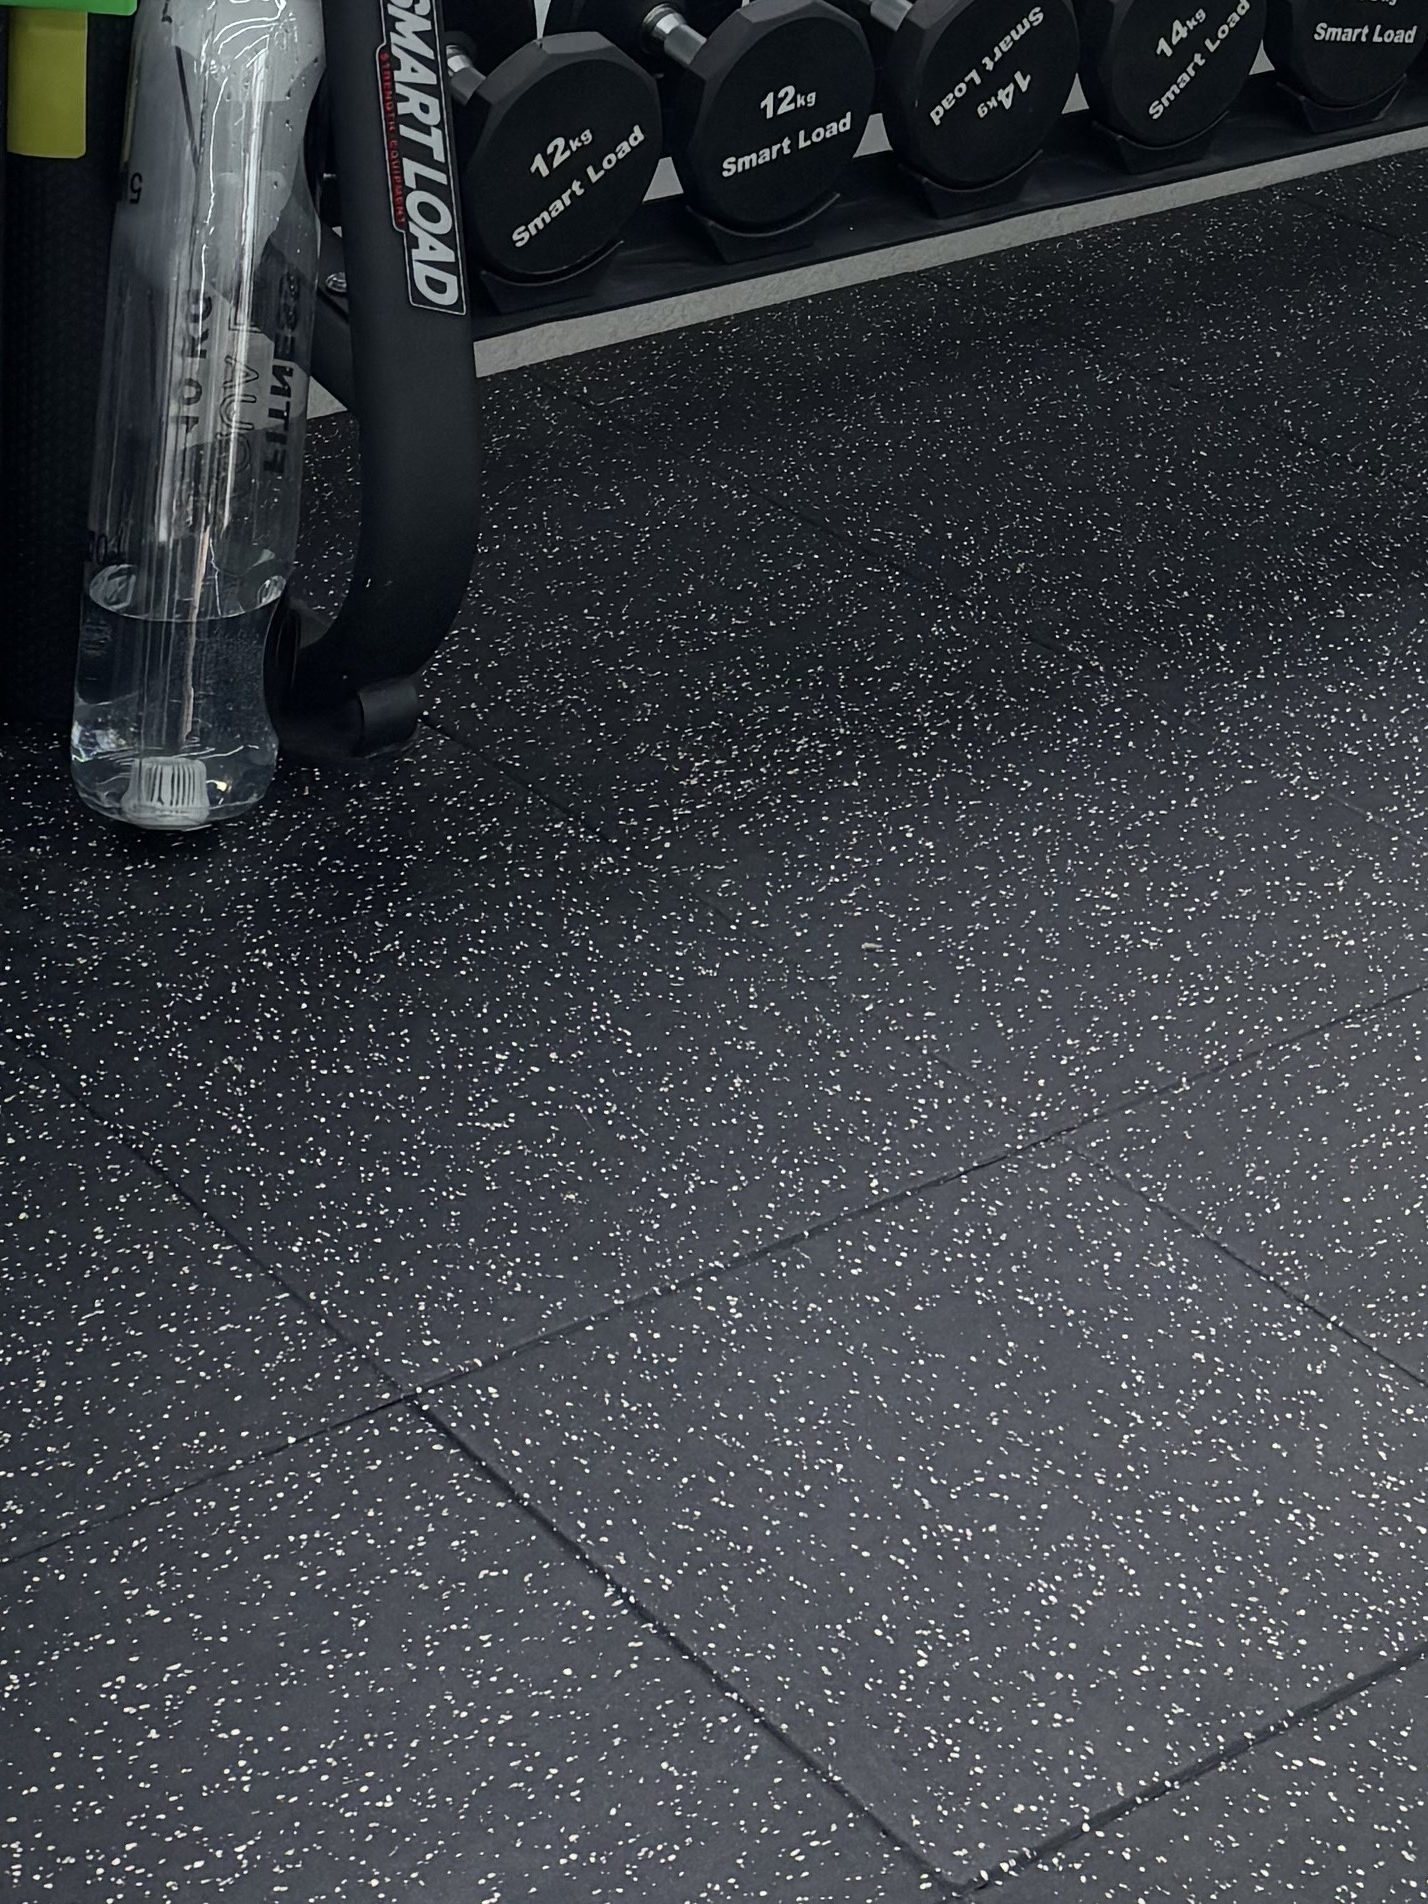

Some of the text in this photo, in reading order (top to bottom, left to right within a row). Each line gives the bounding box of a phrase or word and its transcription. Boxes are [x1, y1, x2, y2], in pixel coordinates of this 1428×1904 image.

[1156, 9, 1205, 56] 14kg
[1314, 23, 1417, 43] Smart Load
[930, 7, 1043, 125] Smart Load
[977, 71, 1030, 117] 14kg
[1149, 53, 1205, 119] Smart
[761, 86, 816, 119] 12kg
[531, 129, 592, 177] 12kg
[722, 112, 851, 177] Smart Load
[512, 125, 644, 247] Smart Load
[401, 157, 460, 307] LOAD
